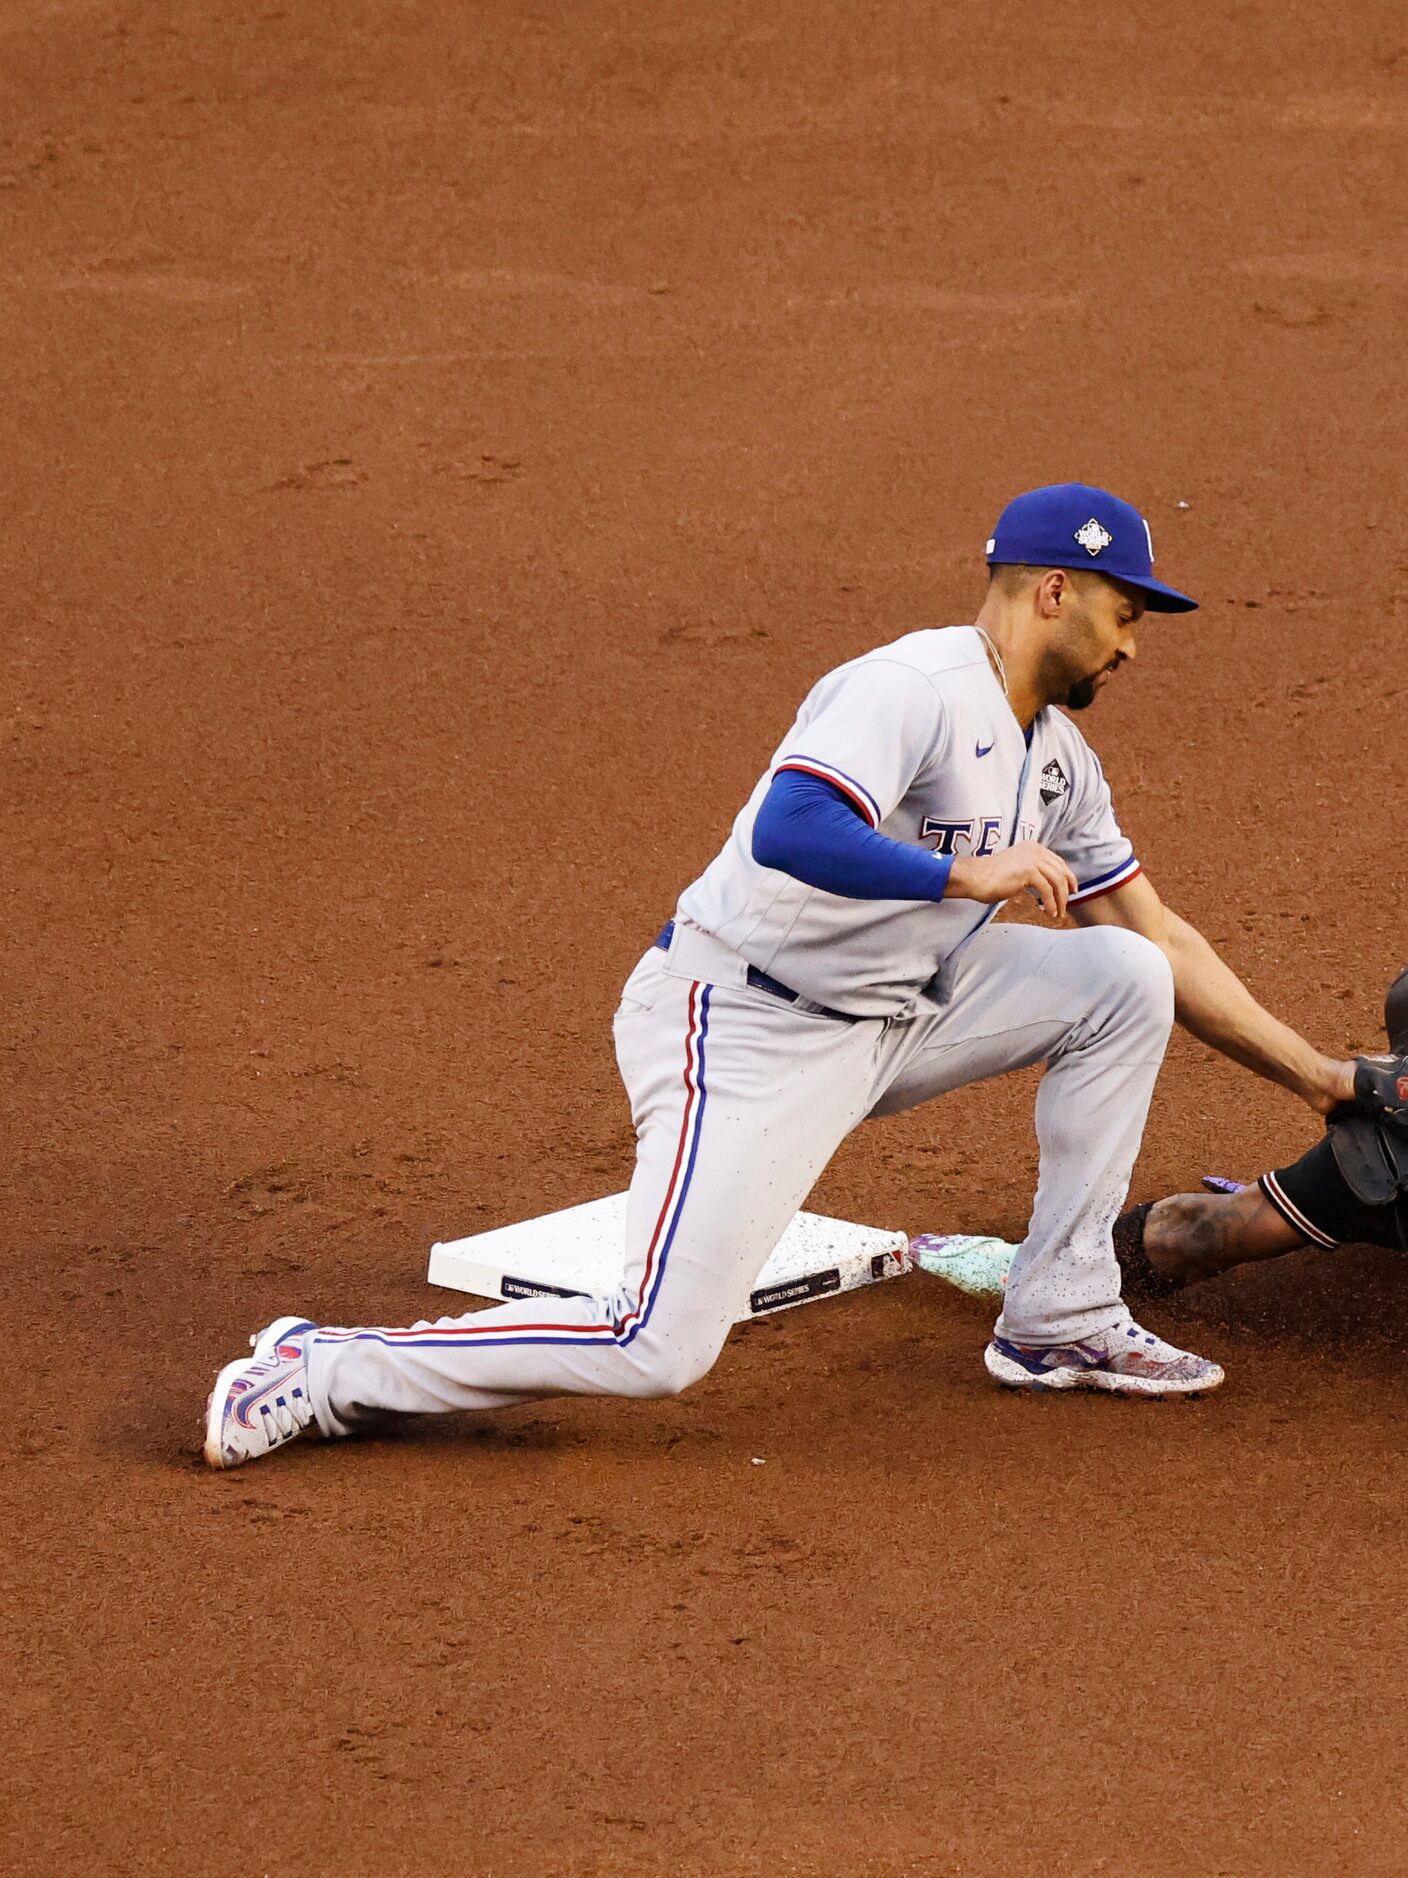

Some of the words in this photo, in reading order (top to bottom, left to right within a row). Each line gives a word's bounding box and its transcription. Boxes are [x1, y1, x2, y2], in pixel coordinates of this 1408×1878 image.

[1040, 772, 1066, 786] WORLD
[514, 1285, 538, 1298] WORLD
[764, 1290, 787, 1304] WORLD
[786, 1284, 810, 1298] SERIES
